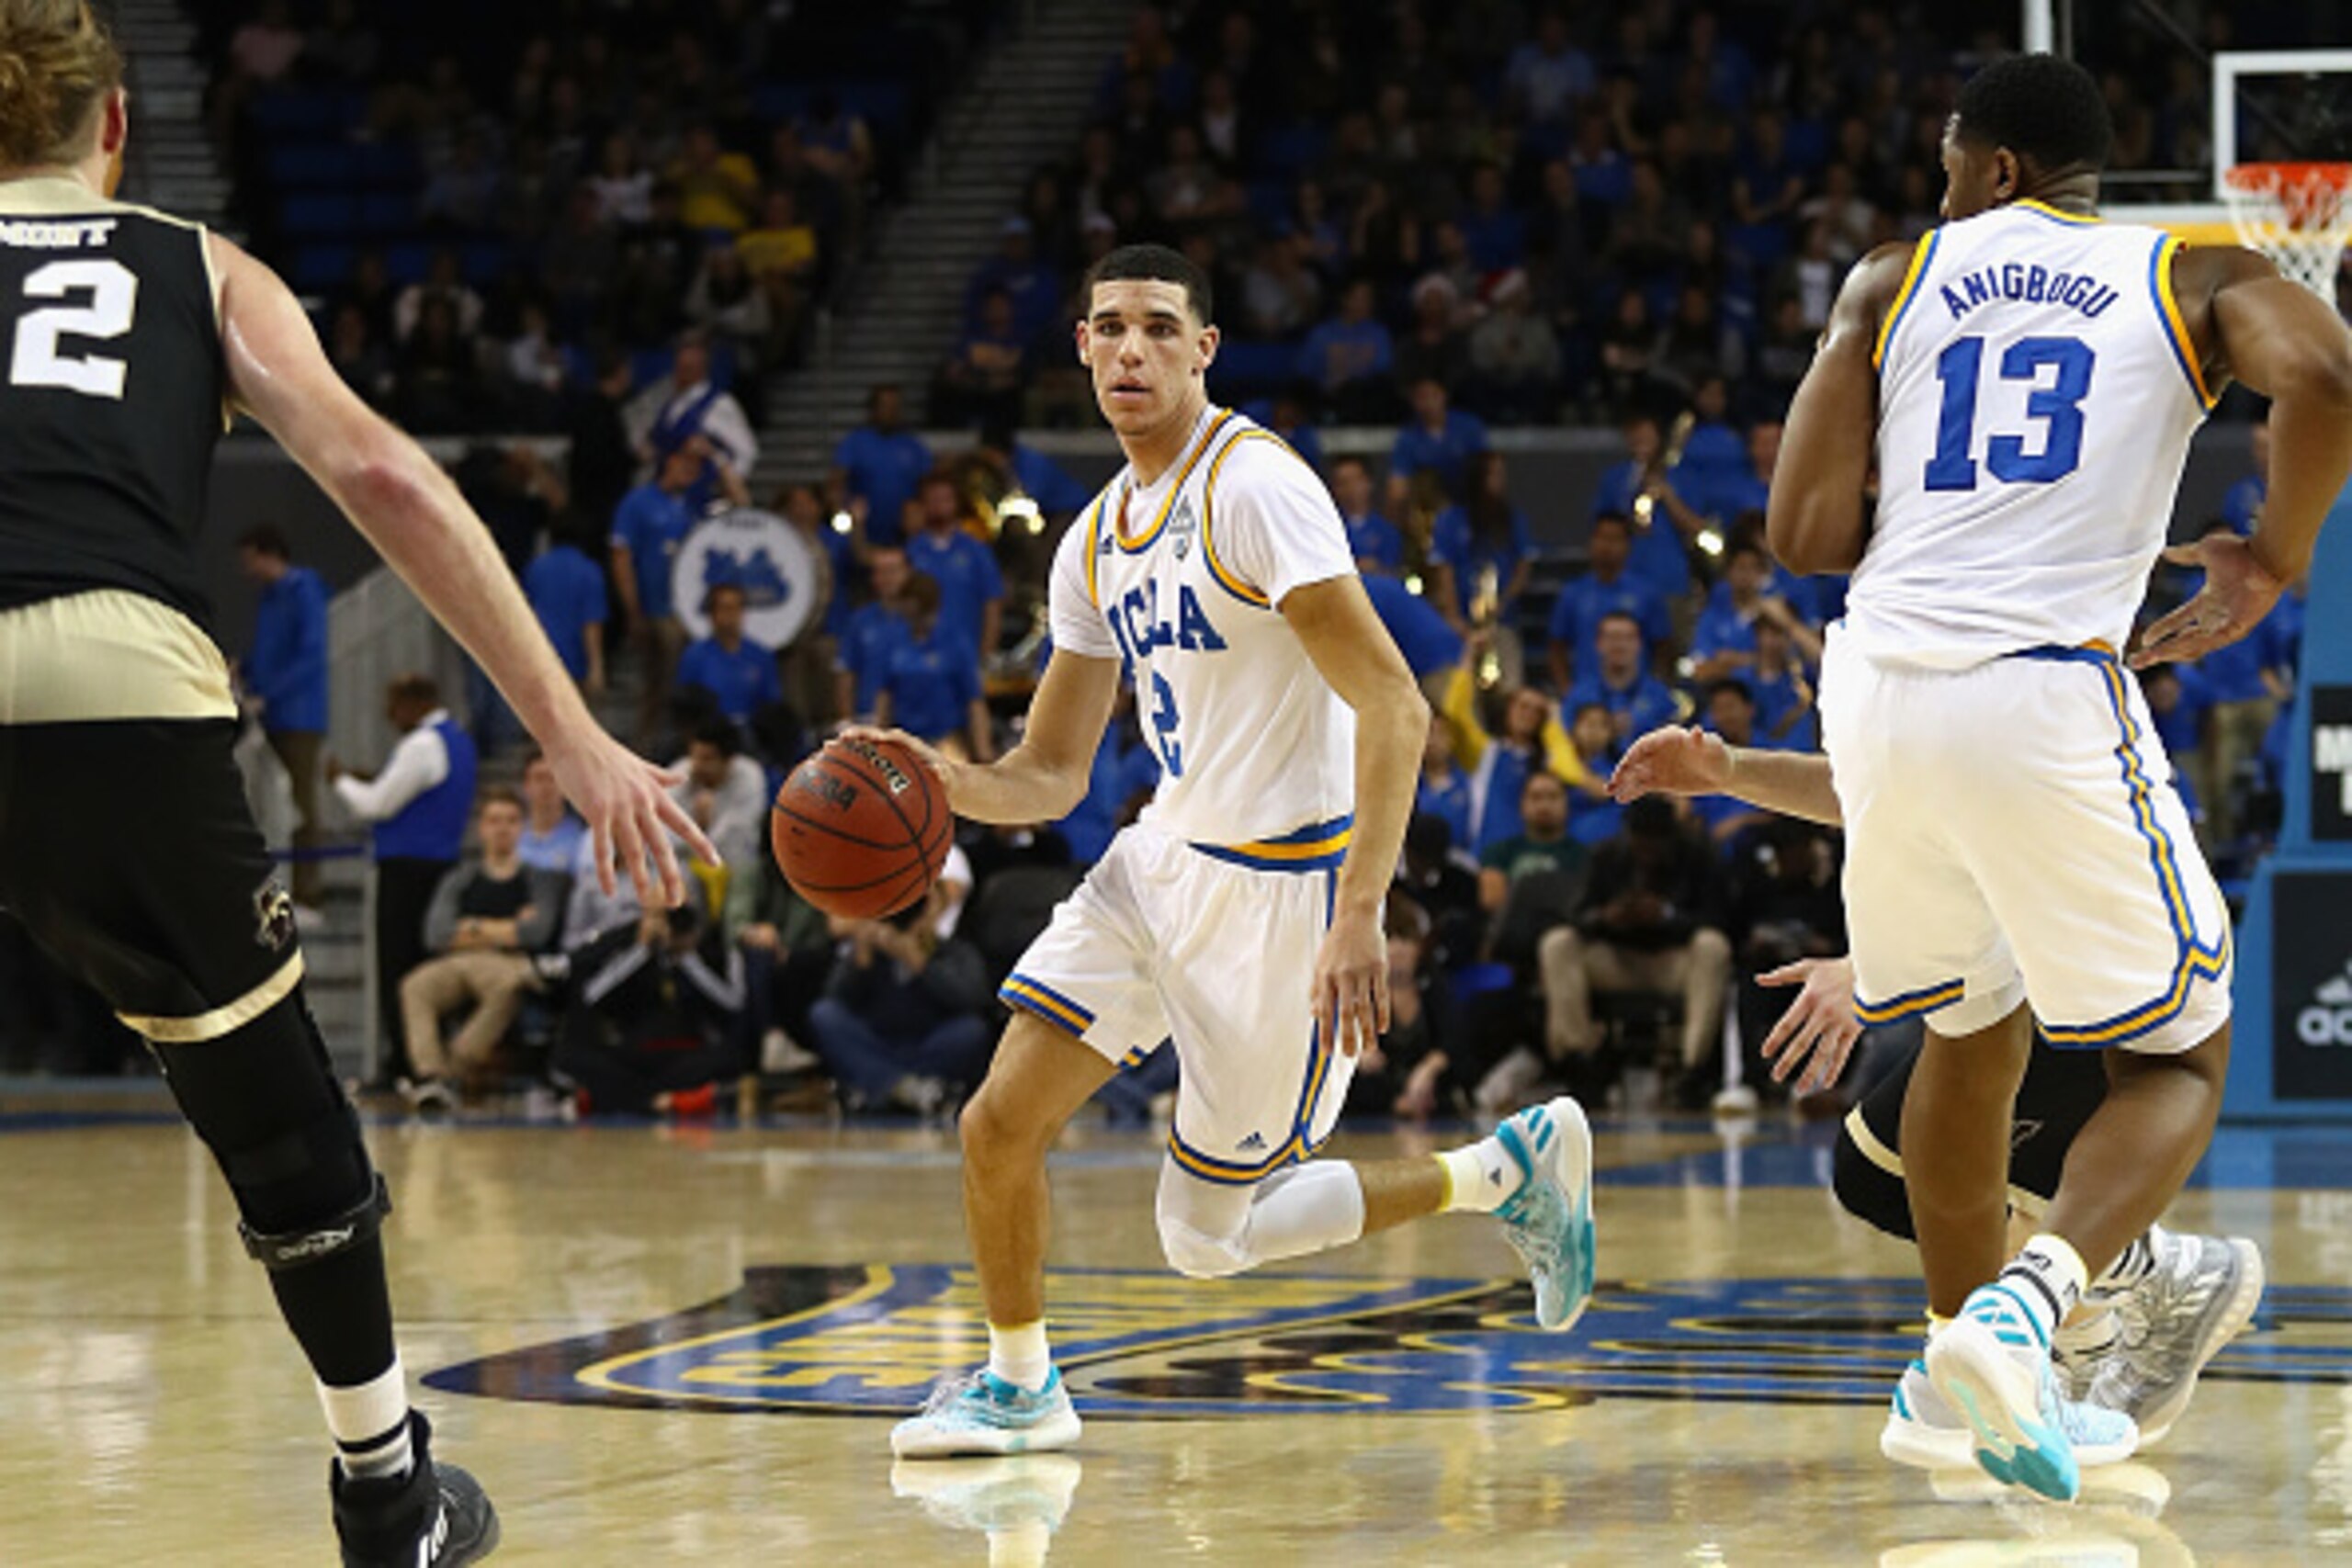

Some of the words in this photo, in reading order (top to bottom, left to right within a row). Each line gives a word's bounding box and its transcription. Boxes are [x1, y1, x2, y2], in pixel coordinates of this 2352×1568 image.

[10, 260, 138, 399] 2
[1940, 263, 2120, 321] ANIGBOGU
[1925, 336, 2096, 491] 13
[1152, 670, 1183, 777] 2
